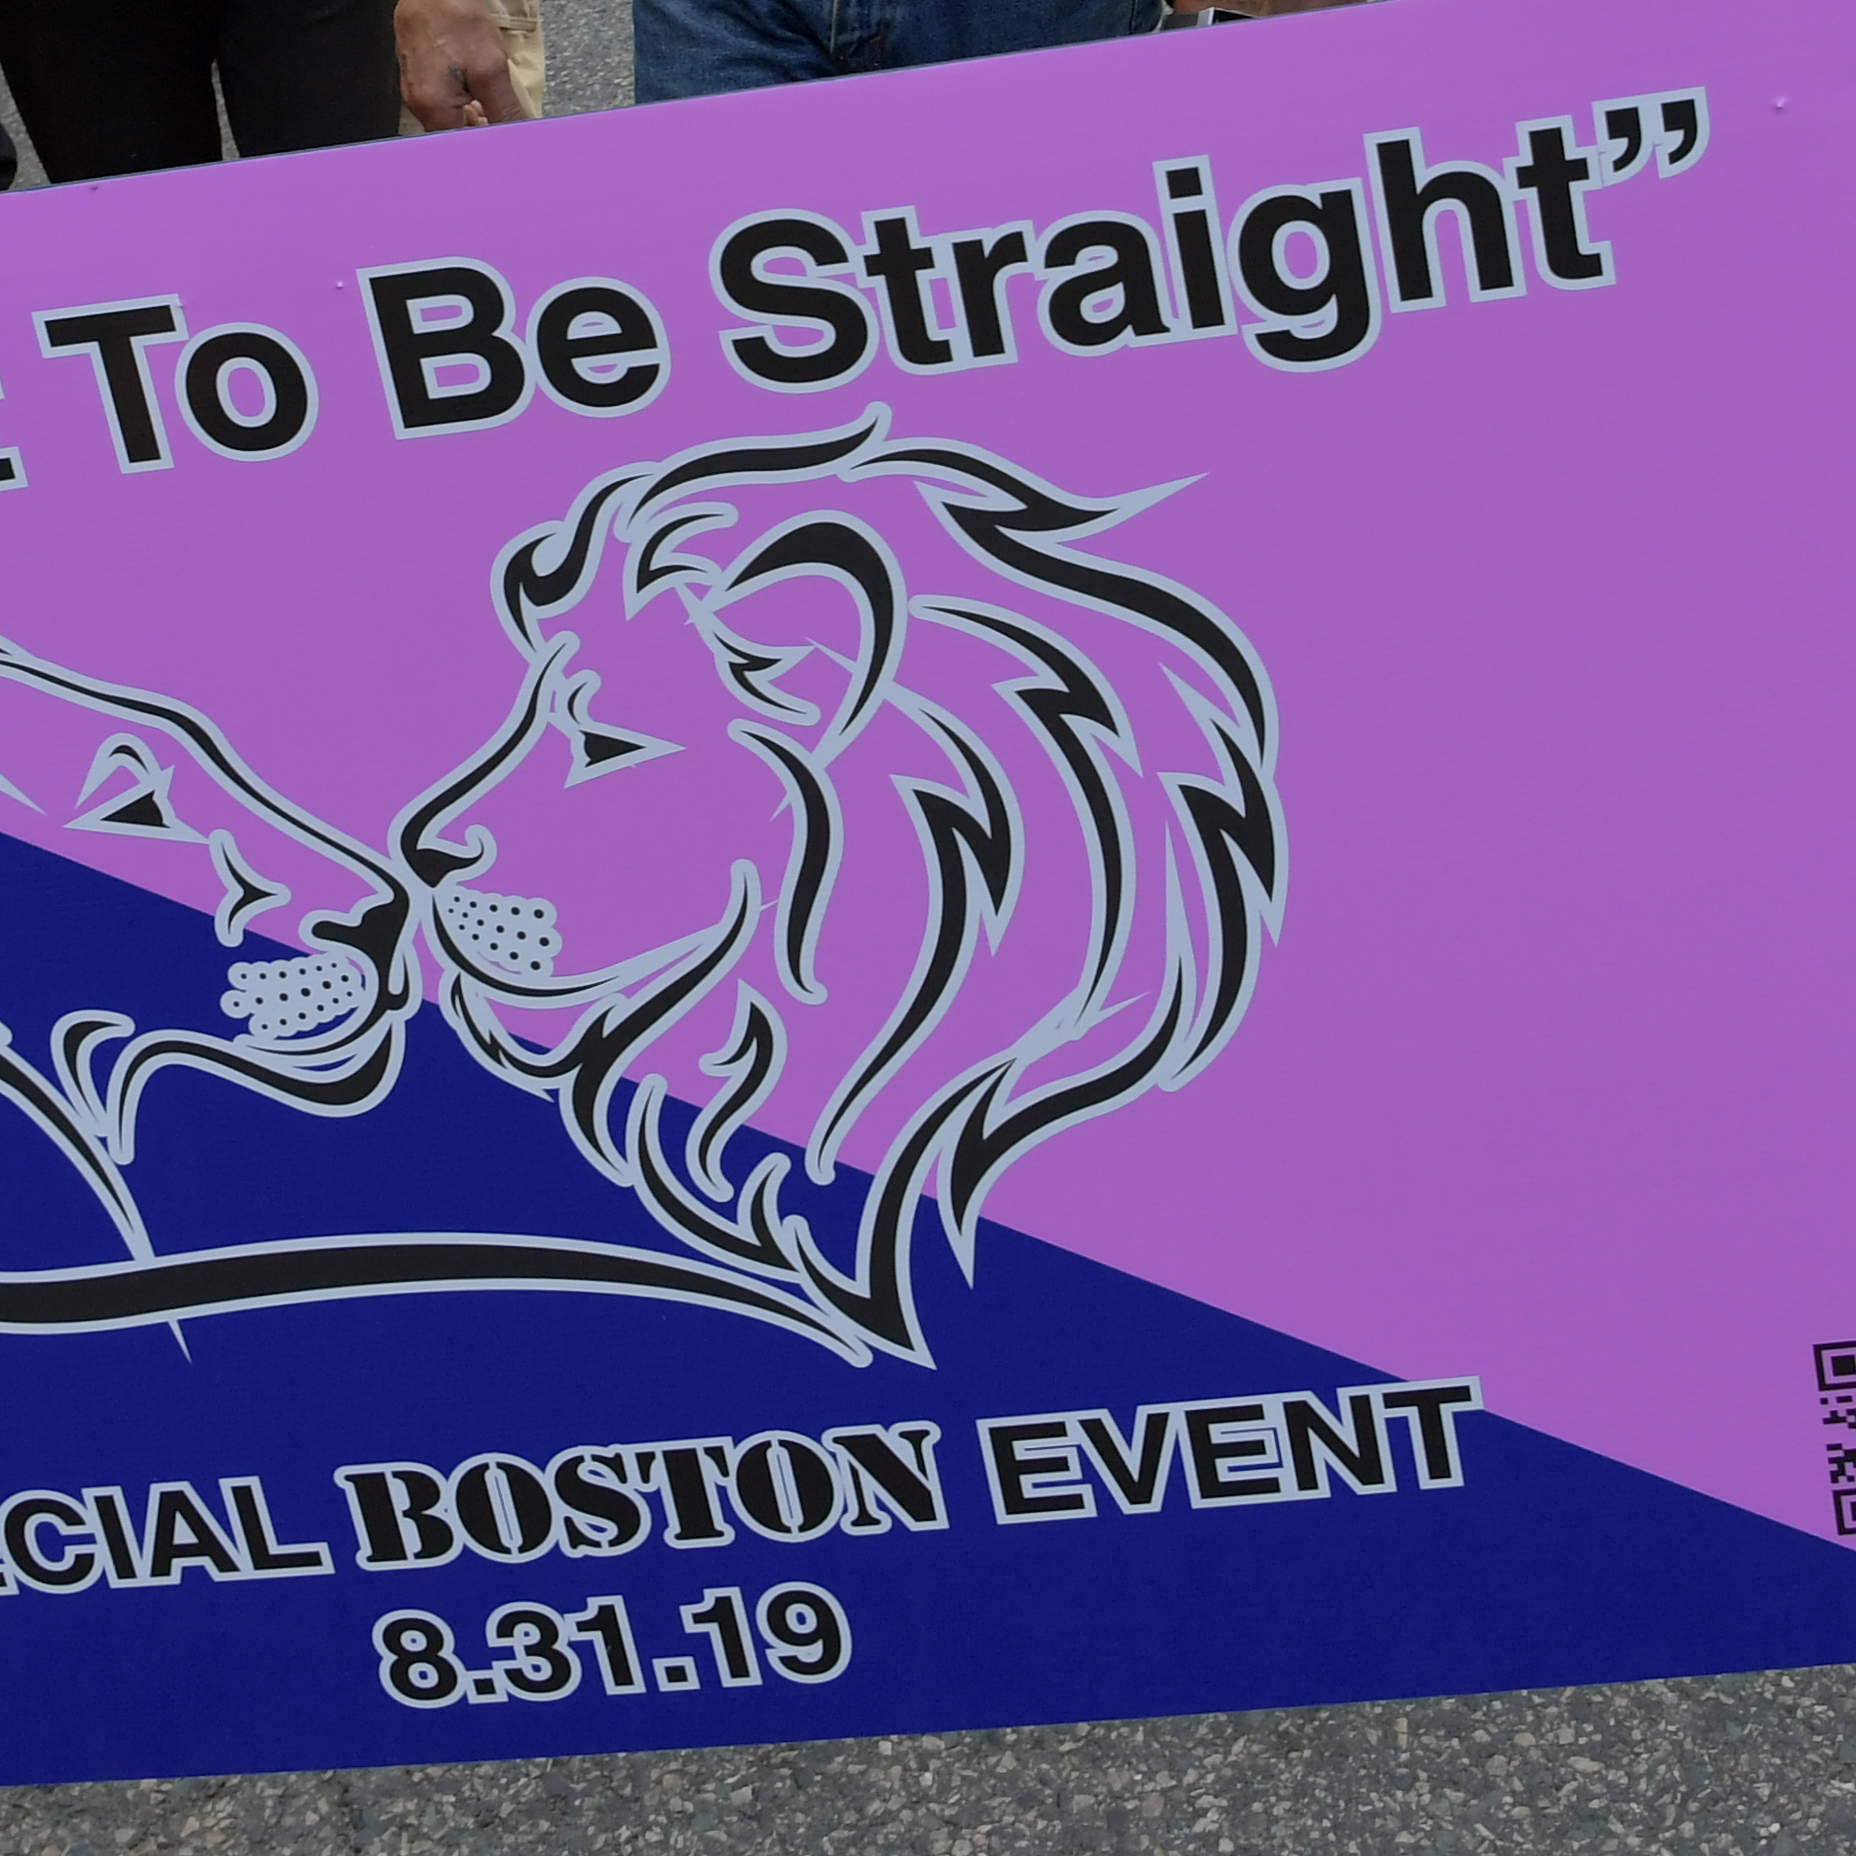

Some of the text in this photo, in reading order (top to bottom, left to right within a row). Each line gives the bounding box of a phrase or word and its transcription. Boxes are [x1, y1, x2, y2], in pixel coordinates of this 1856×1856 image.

[33, 292, 321, 475] To
[355, 257, 671, 440] Be
[709, 85, 1712, 396] Straight”
[334, 1419, 943, 1574] BOSTON
[976, 1374, 1488, 1528] EVENT
[371, 1579, 853, 1710] 8.31.19
